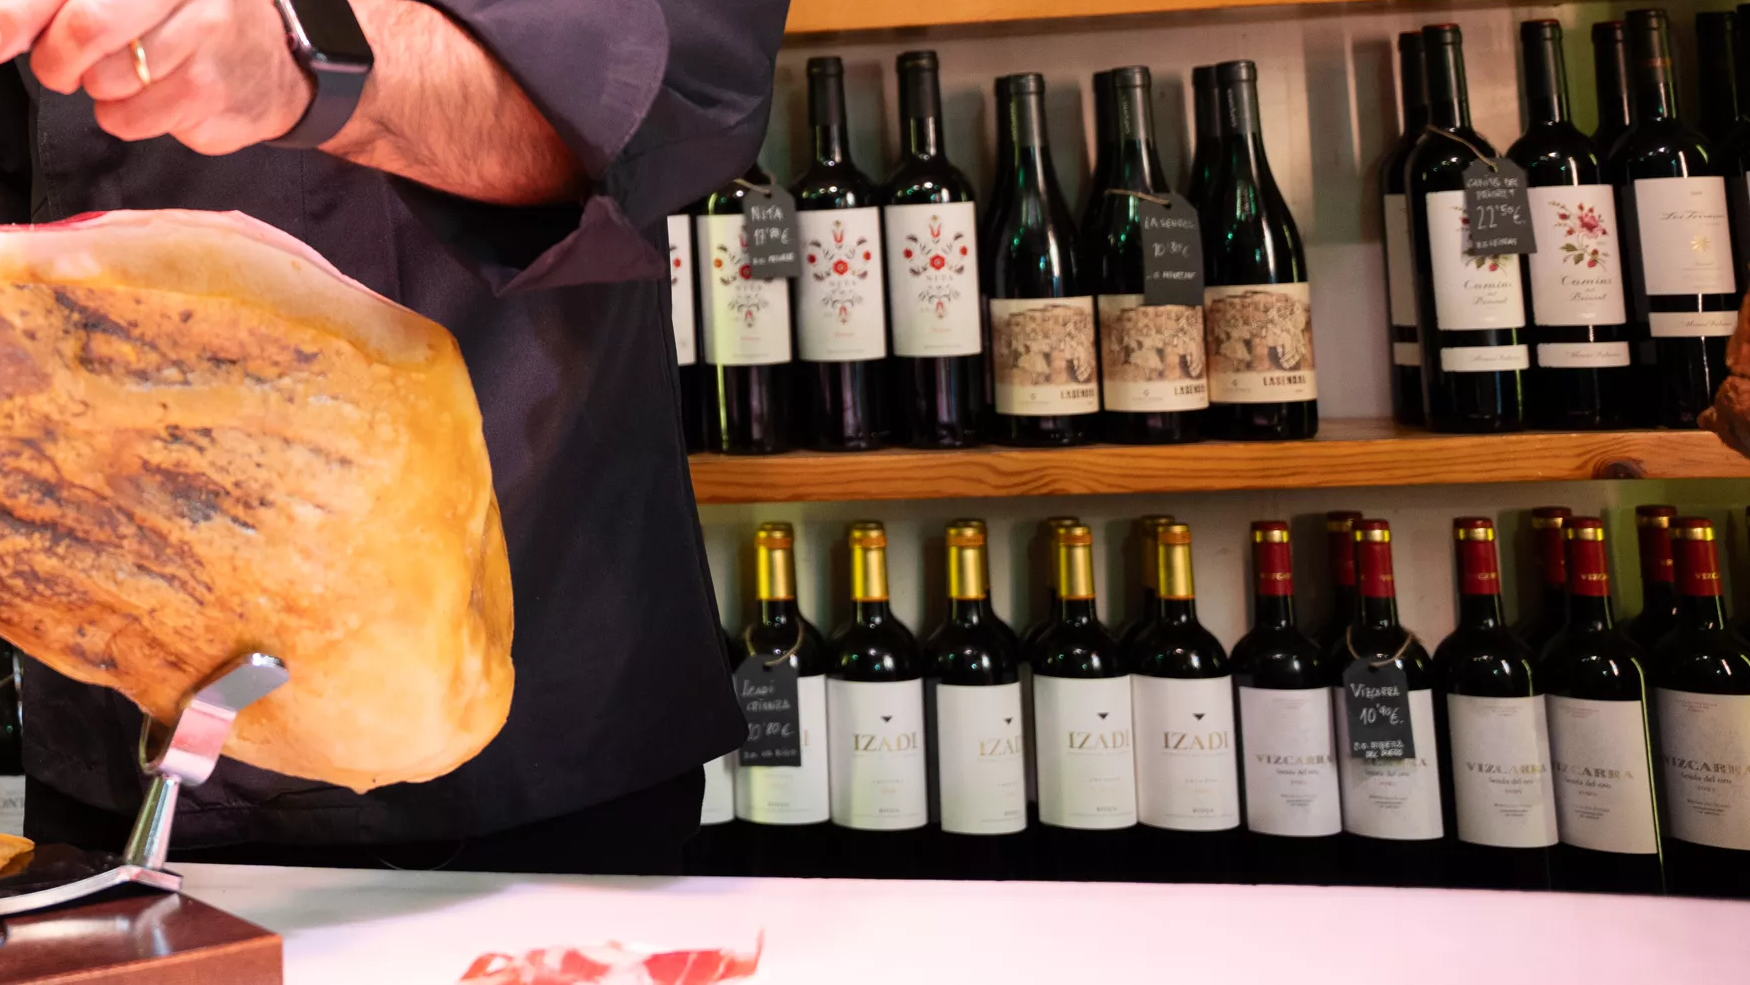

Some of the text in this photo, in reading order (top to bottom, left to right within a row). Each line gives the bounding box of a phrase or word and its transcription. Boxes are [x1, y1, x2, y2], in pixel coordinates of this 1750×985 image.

[853, 732, 918, 752] IZADI
[1067, 729, 1130, 750] IZADI
[1163, 731, 1229, 751] IZADI
